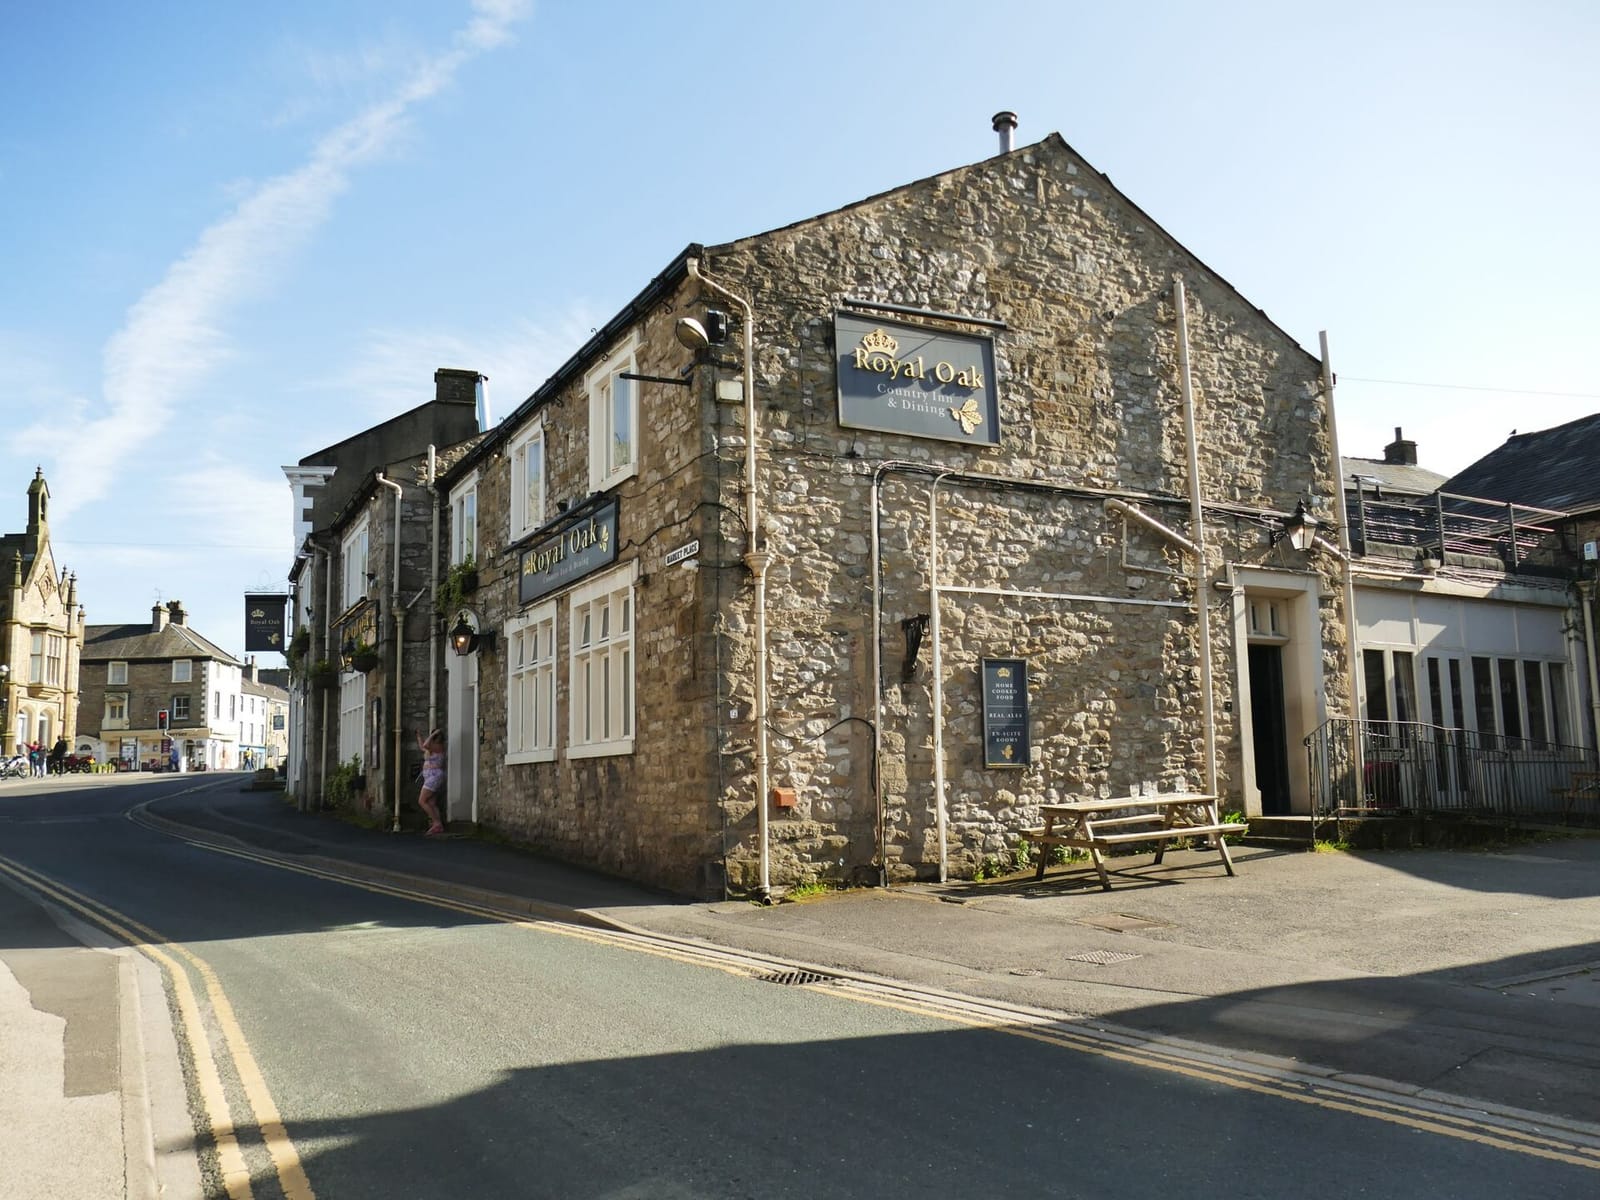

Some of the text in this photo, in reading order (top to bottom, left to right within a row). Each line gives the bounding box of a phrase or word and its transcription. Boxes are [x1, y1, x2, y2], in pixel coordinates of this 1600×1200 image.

[855, 347, 984, 388] Royal Oak
[877, 383, 953, 403] Country Inn
[887, 398, 945, 417] & Dining
[530, 517, 597, 574] Royal Oak
